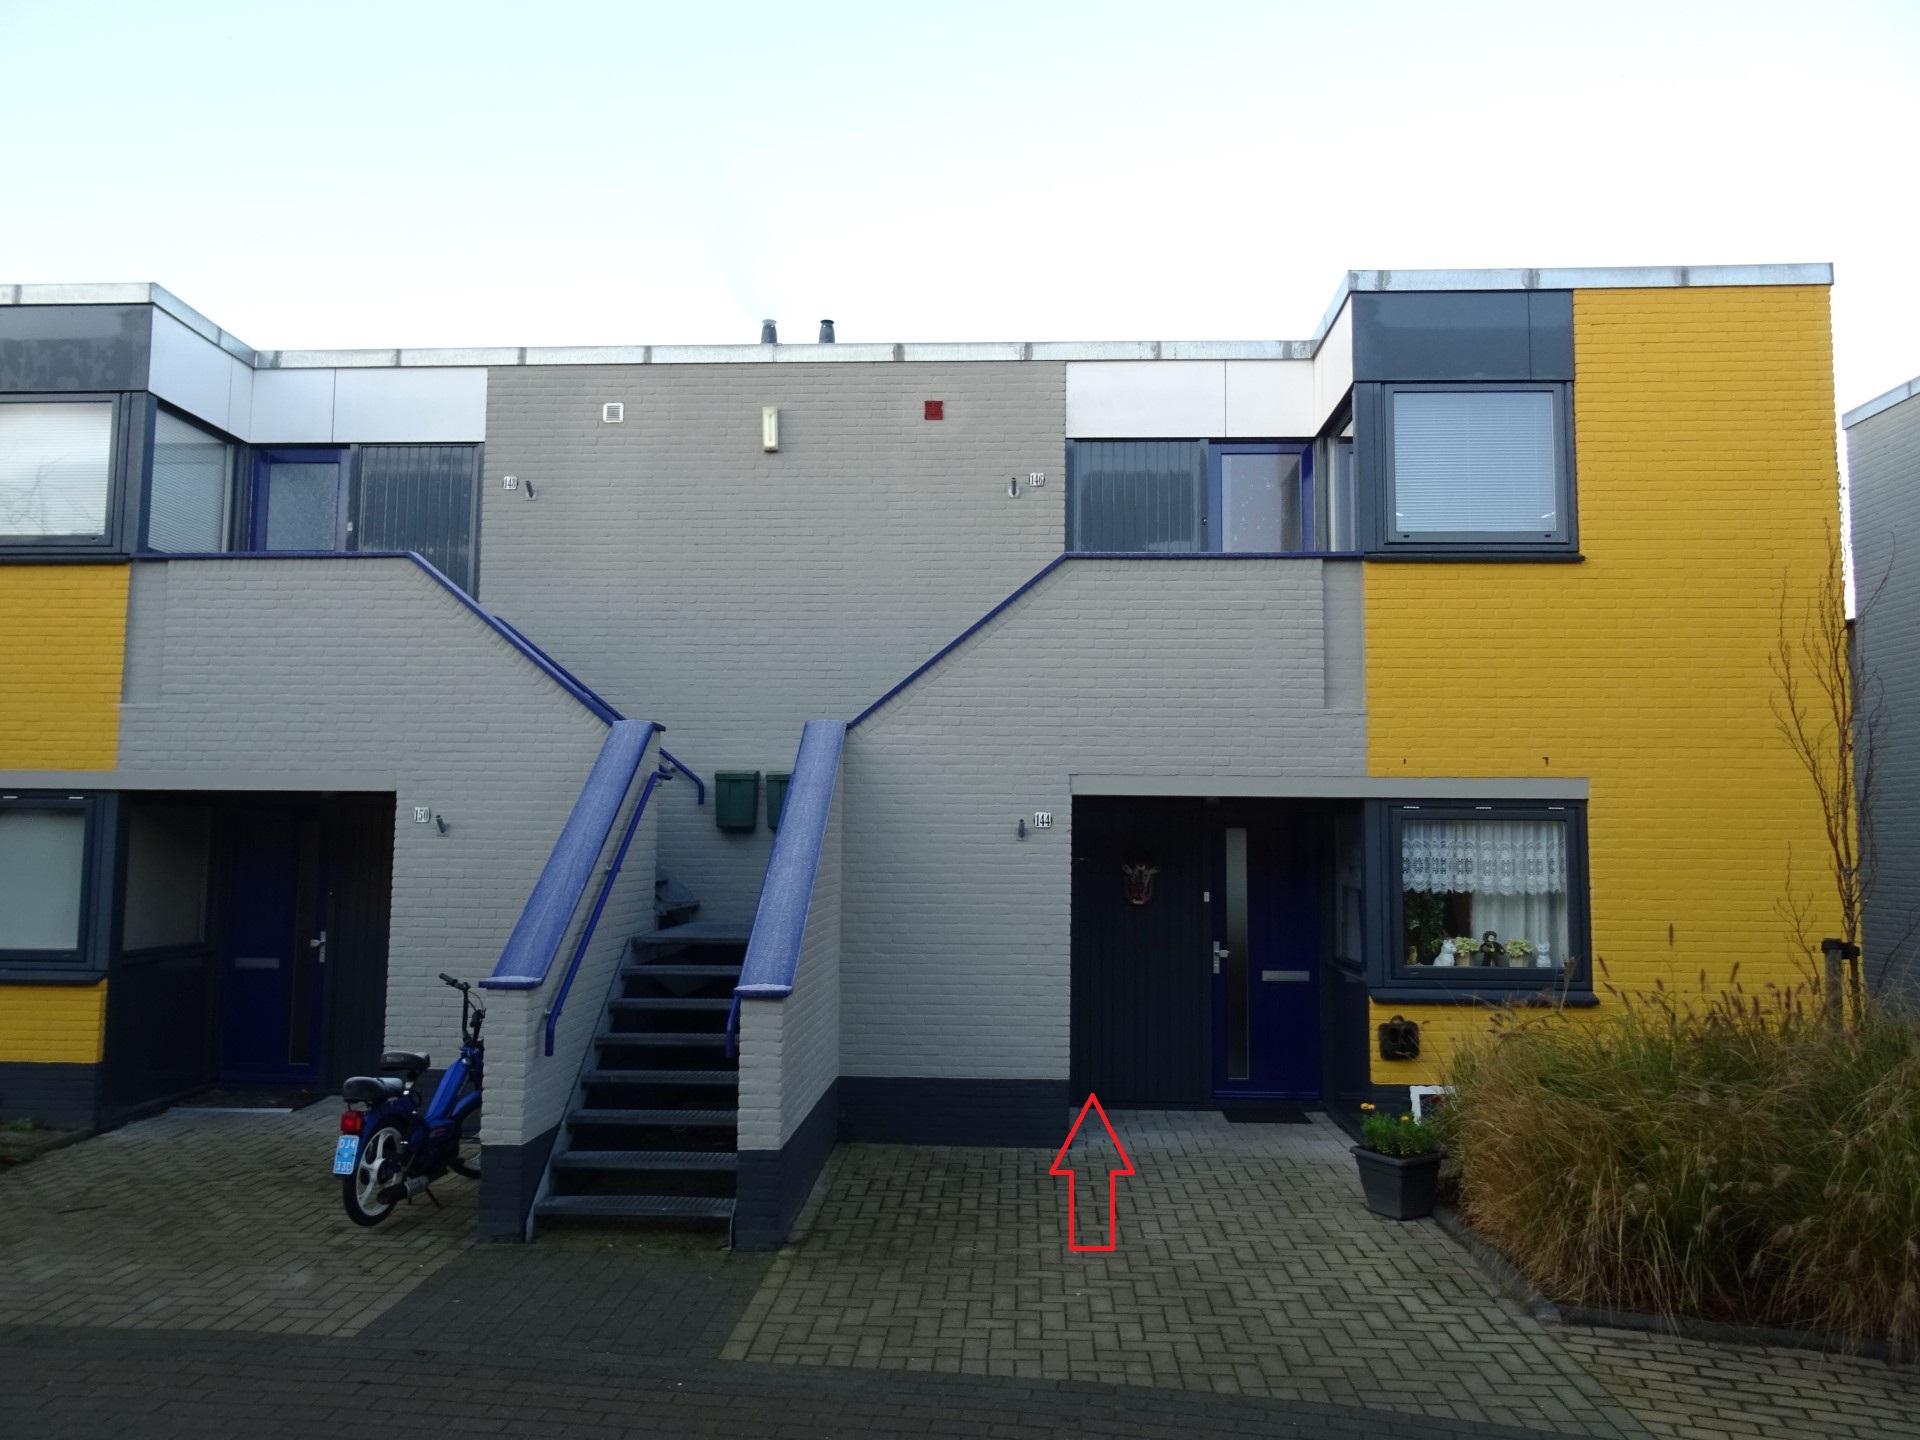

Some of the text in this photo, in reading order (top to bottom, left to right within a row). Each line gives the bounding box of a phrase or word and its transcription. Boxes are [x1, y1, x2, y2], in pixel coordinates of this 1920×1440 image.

[504, 477, 517, 489] 148
[1031, 473, 1044, 486] 146
[415, 808, 429, 822] 150
[1036, 813, 1050, 827] 144
[339, 1138, 357, 1149] DJ4
